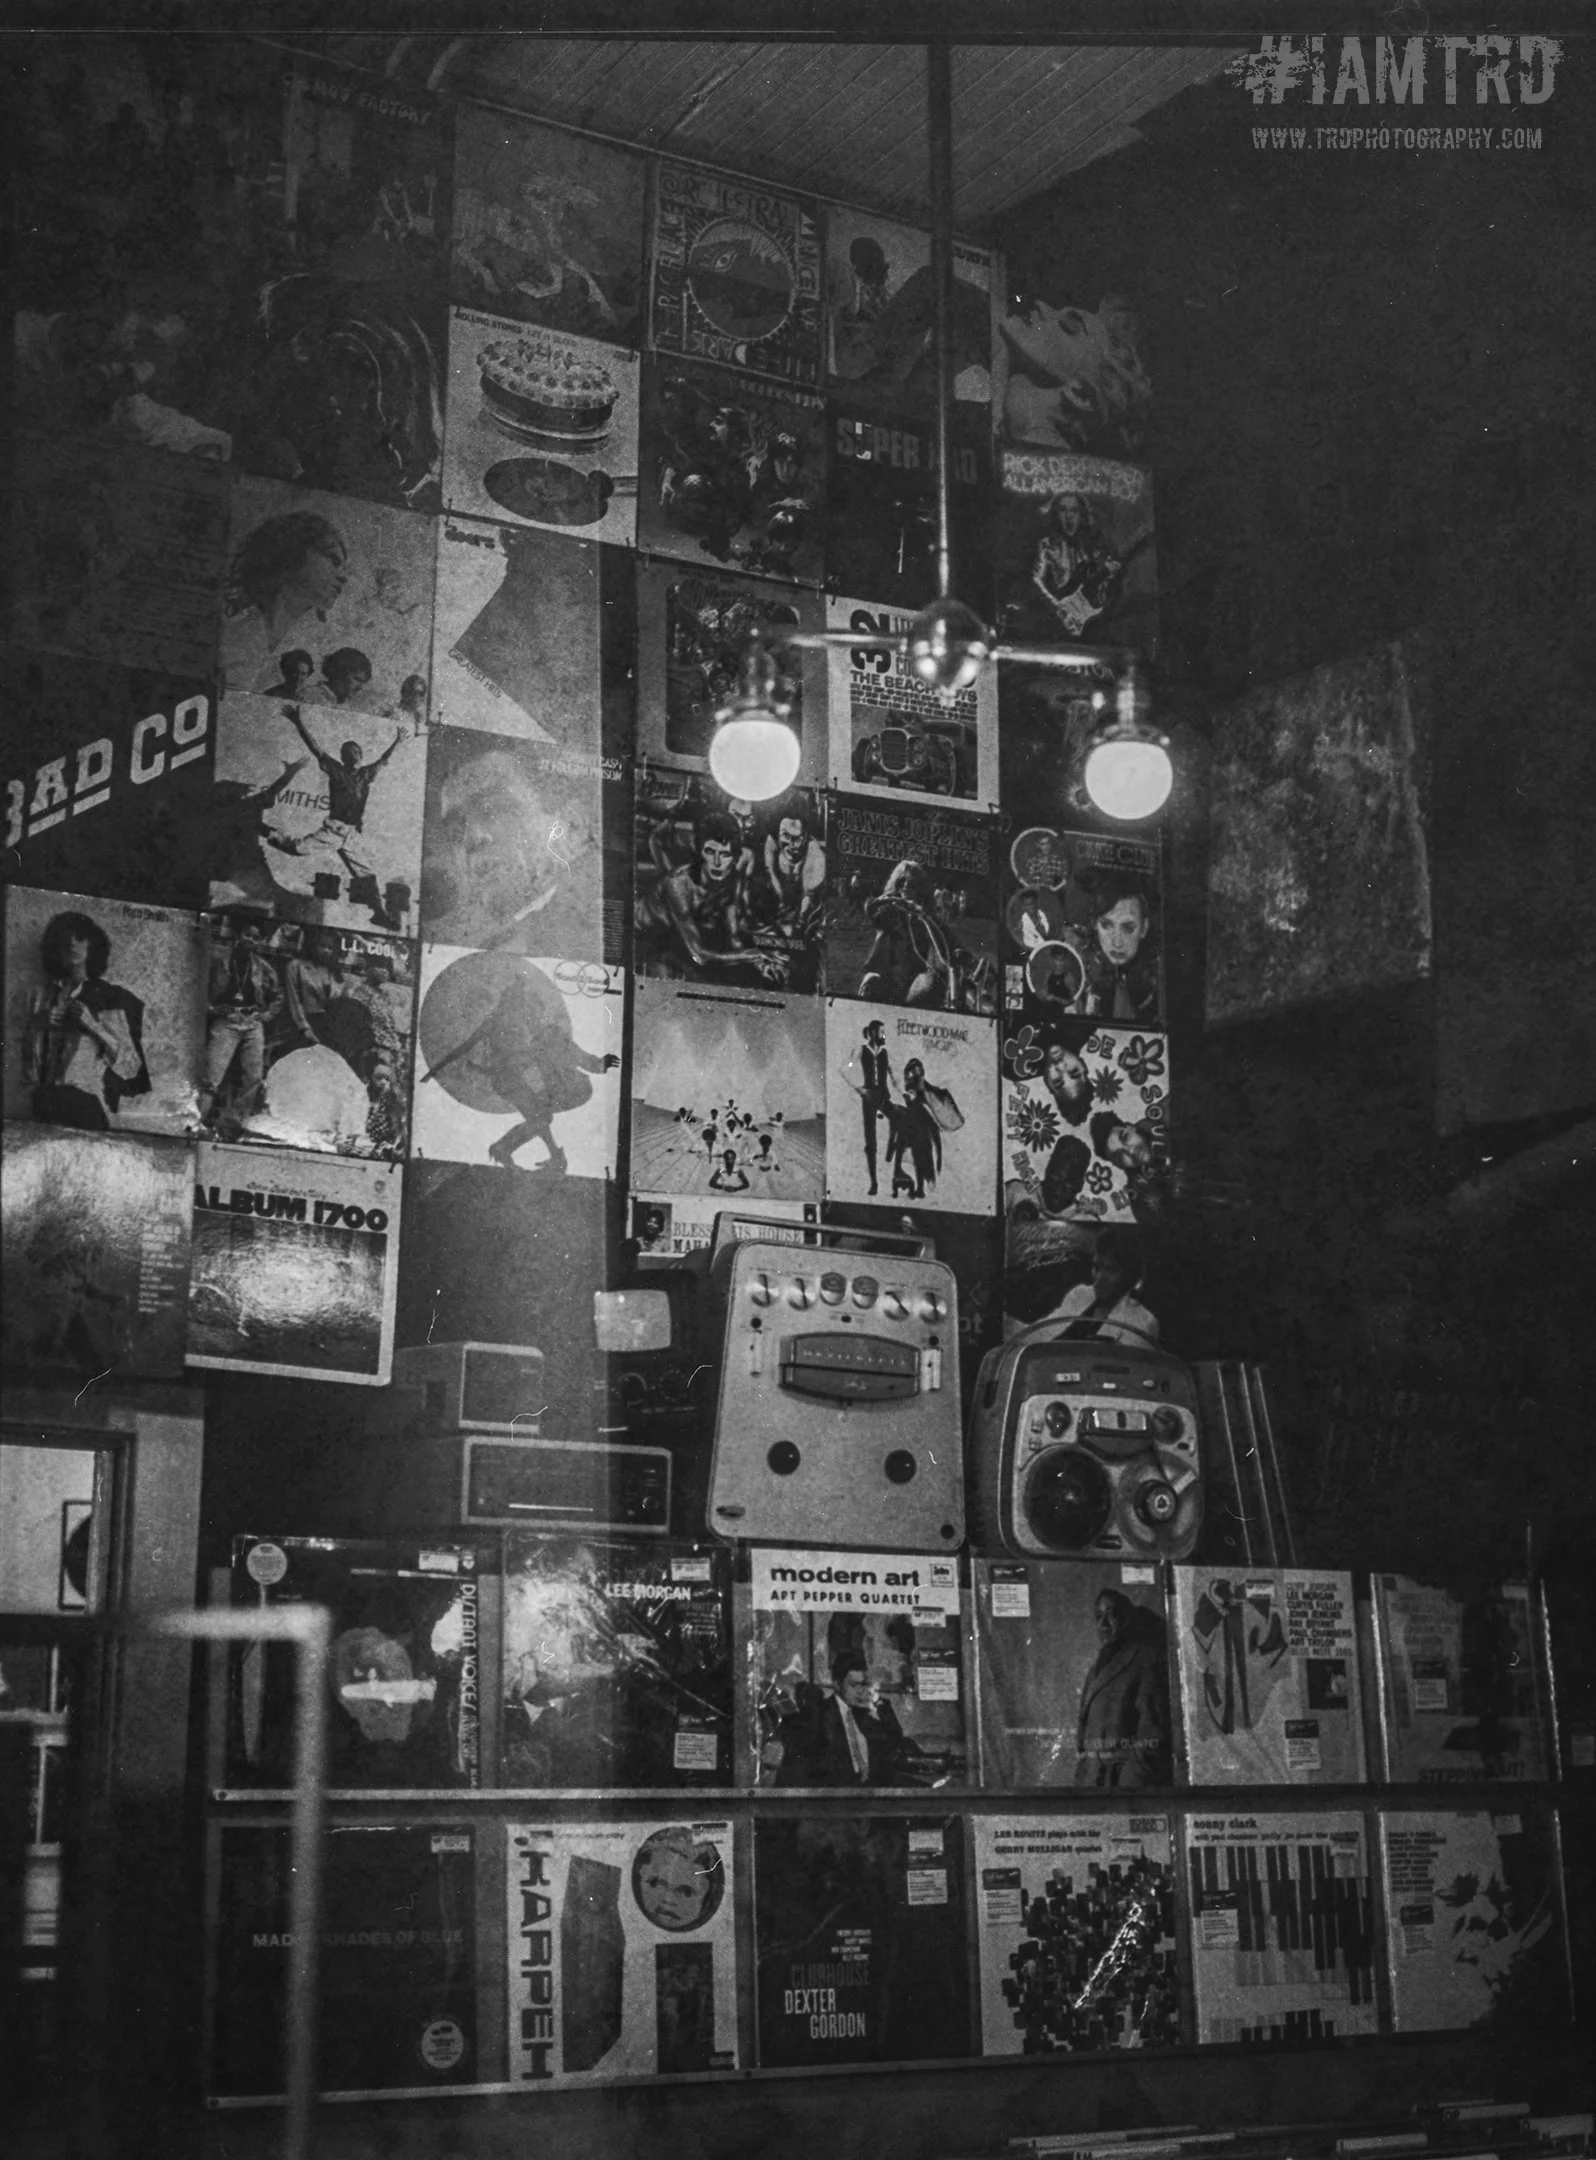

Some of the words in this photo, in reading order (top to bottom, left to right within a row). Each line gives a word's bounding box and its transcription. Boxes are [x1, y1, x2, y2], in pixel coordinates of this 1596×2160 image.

[837, 417, 920, 469] SUPER
[850, 670, 881, 686] THE
[130, 694, 209, 785] CO
[277, 789, 331, 811] MITHS
[837, 807, 900, 839] JANIS
[940, 847, 990, 876] HITS
[312, 1200, 387, 1231] 1700
[673, 1222, 714, 1238] BLESS
[758, 1230, 804, 1246] HOUSE
[673, 1239, 712, 1254] MAHA
[770, 1567, 857, 1586] modern
[884, 1570, 921, 1588] art
[604, 1582, 632, 1599] LEE
[633, 1583, 692, 1601] MORGAN
[770, 1589, 796, 1602] ART
[803, 1591, 853, 1605] PEPPER
[860, 1592, 921, 1607] QUARTET
[1193, 1820, 1226, 1833] sonny
[1228, 1817, 1258, 1830] clark
[790, 1962, 871, 1989] CLUBHOUSE
[784, 1987, 836, 2015] DEXTER
[809, 2012, 867, 2040] GORDON
